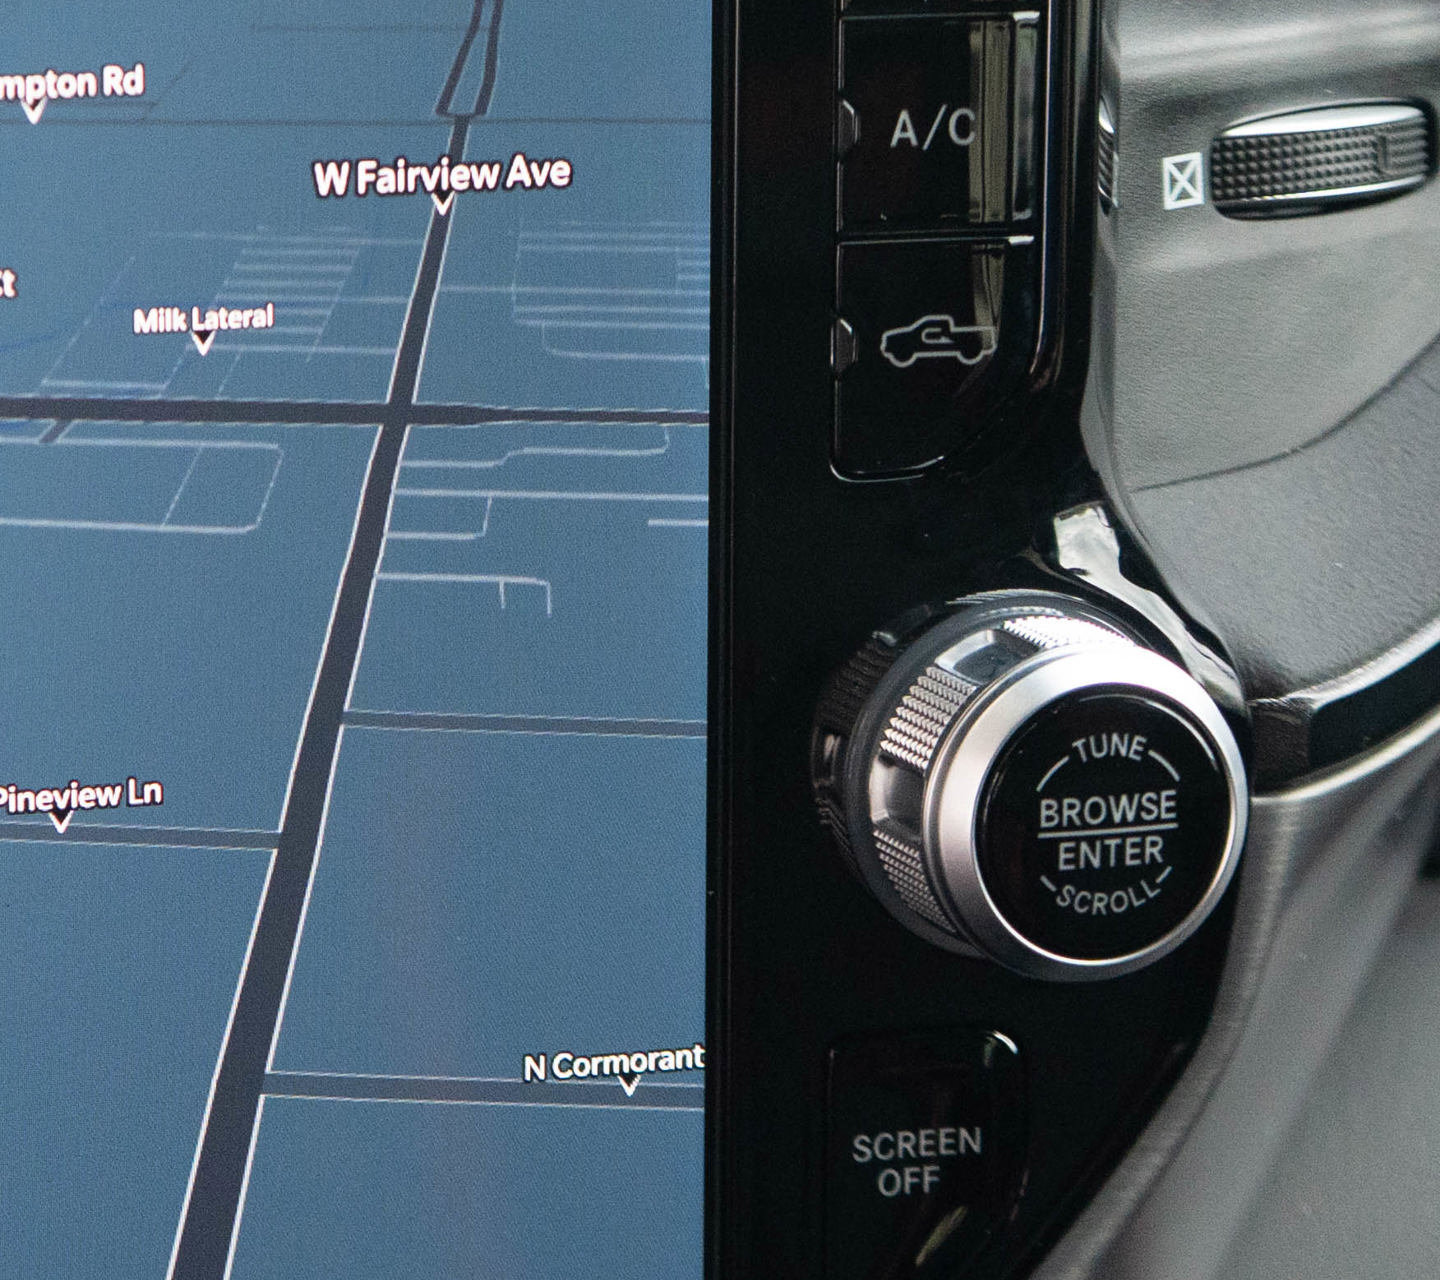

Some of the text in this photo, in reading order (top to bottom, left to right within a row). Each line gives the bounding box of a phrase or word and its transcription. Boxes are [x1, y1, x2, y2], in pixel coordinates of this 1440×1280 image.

[101, 63, 144, 97] Rd
[889, 104, 977, 150] A/C
[313, 154, 573, 197] W Fairview Ave
[133, 303, 274, 334] Milk Lateral
[1072, 733, 1149, 762] TUNE
[128, 778, 163, 808] Ln
[1039, 789, 1178, 829] BROWSE
[1058, 836, 1164, 871] ENTER
[1055, 879, 1162, 916] SCROLL
[524, 1043, 706, 1082] N Cormorant
[852, 1127, 982, 1163] SCREEN
[877, 1166, 941, 1197] OFF
